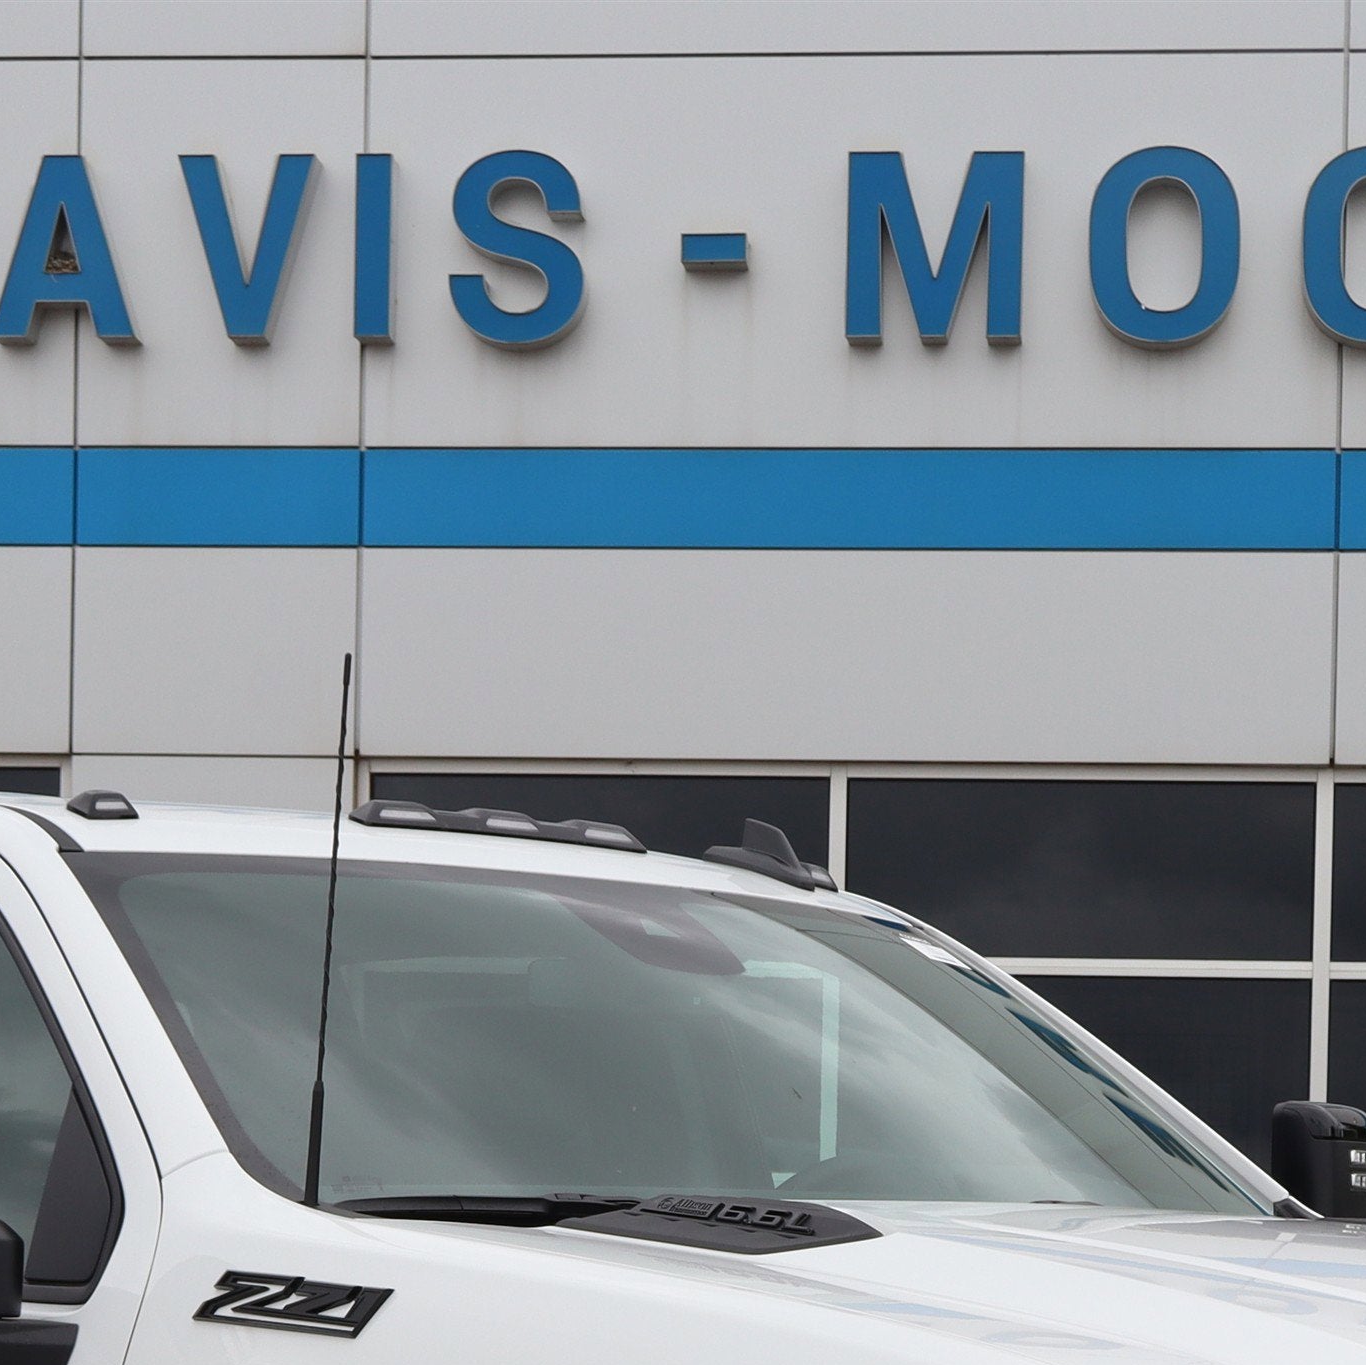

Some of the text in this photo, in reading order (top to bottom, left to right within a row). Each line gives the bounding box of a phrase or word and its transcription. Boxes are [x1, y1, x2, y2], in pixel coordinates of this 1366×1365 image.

[668, 1198, 714, 1212] Allison
[716, 1204, 816, 1236] 6.6L
[192, 1269, 395, 1340] Z71
